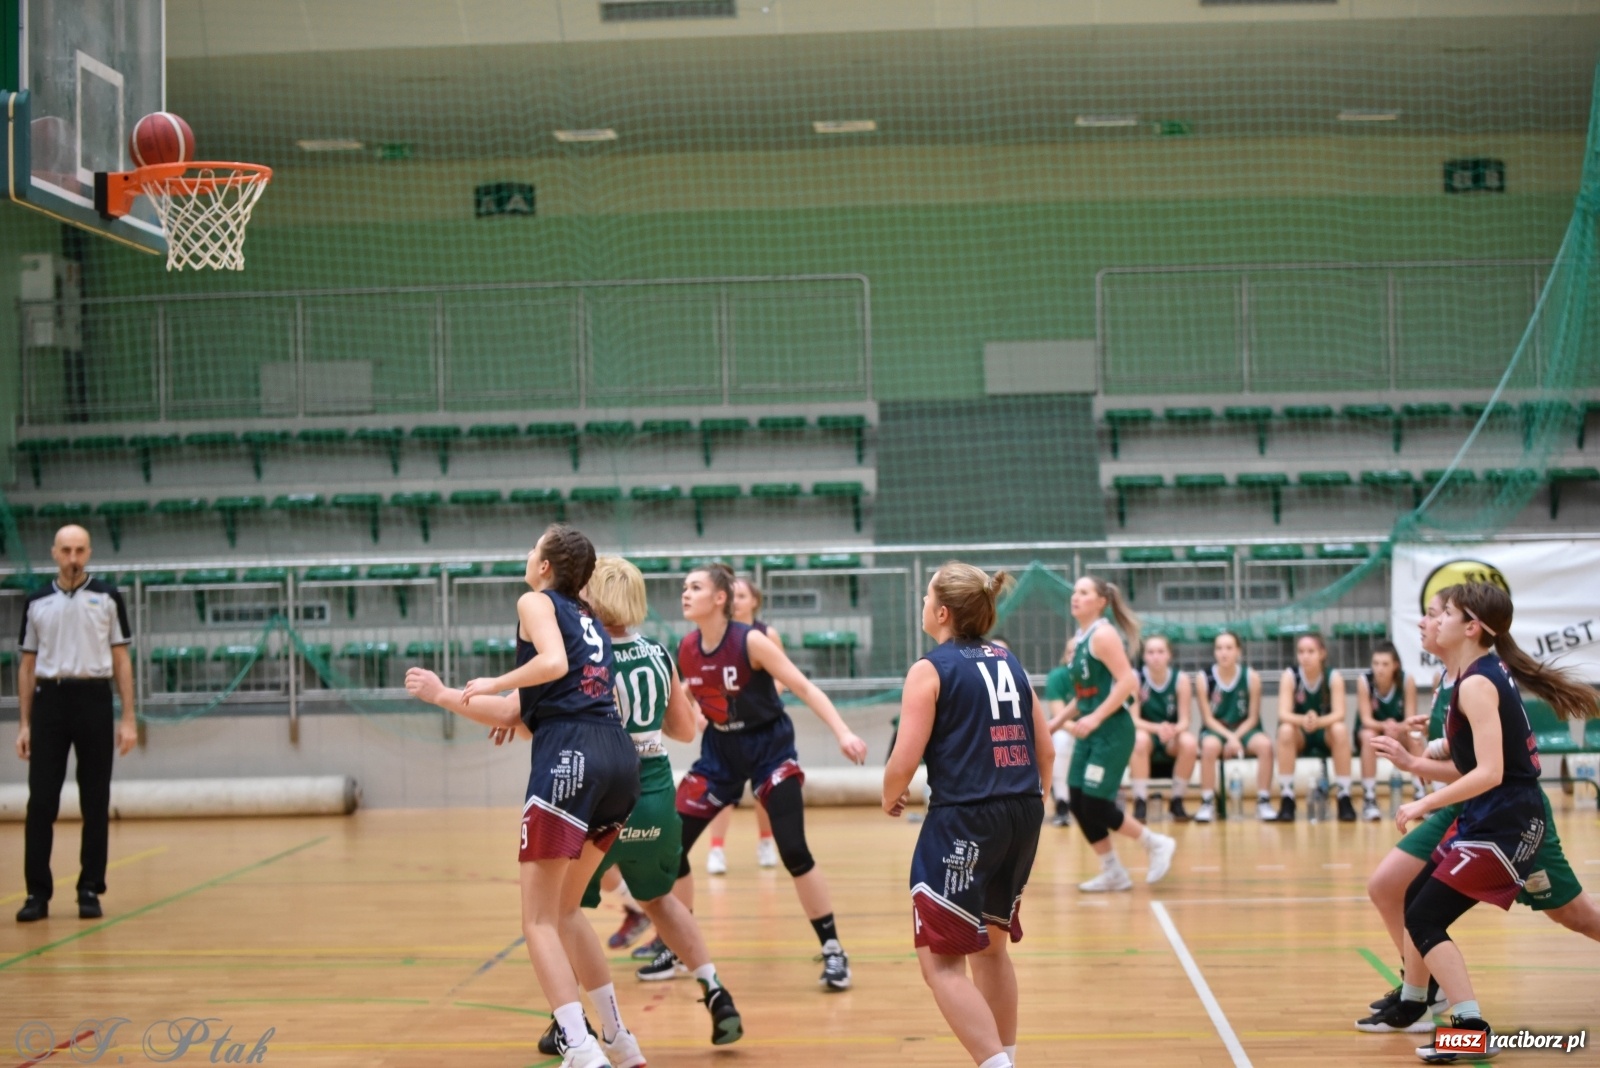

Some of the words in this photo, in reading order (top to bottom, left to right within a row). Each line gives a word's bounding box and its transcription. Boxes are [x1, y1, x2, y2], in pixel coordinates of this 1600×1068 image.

[580, 617, 603, 662] 9
[1533, 620, 1592, 658] JEST
[723, 666, 740, 690] 12
[976, 660, 1021, 719] 14
[615, 666, 657, 729] 10
[993, 745, 1030, 767] POLSKA
[521, 823, 528, 849] 9
[618, 826, 661, 840] Clavis
[942, 856, 959, 865] Love
[1450, 853, 1471, 875] 7
